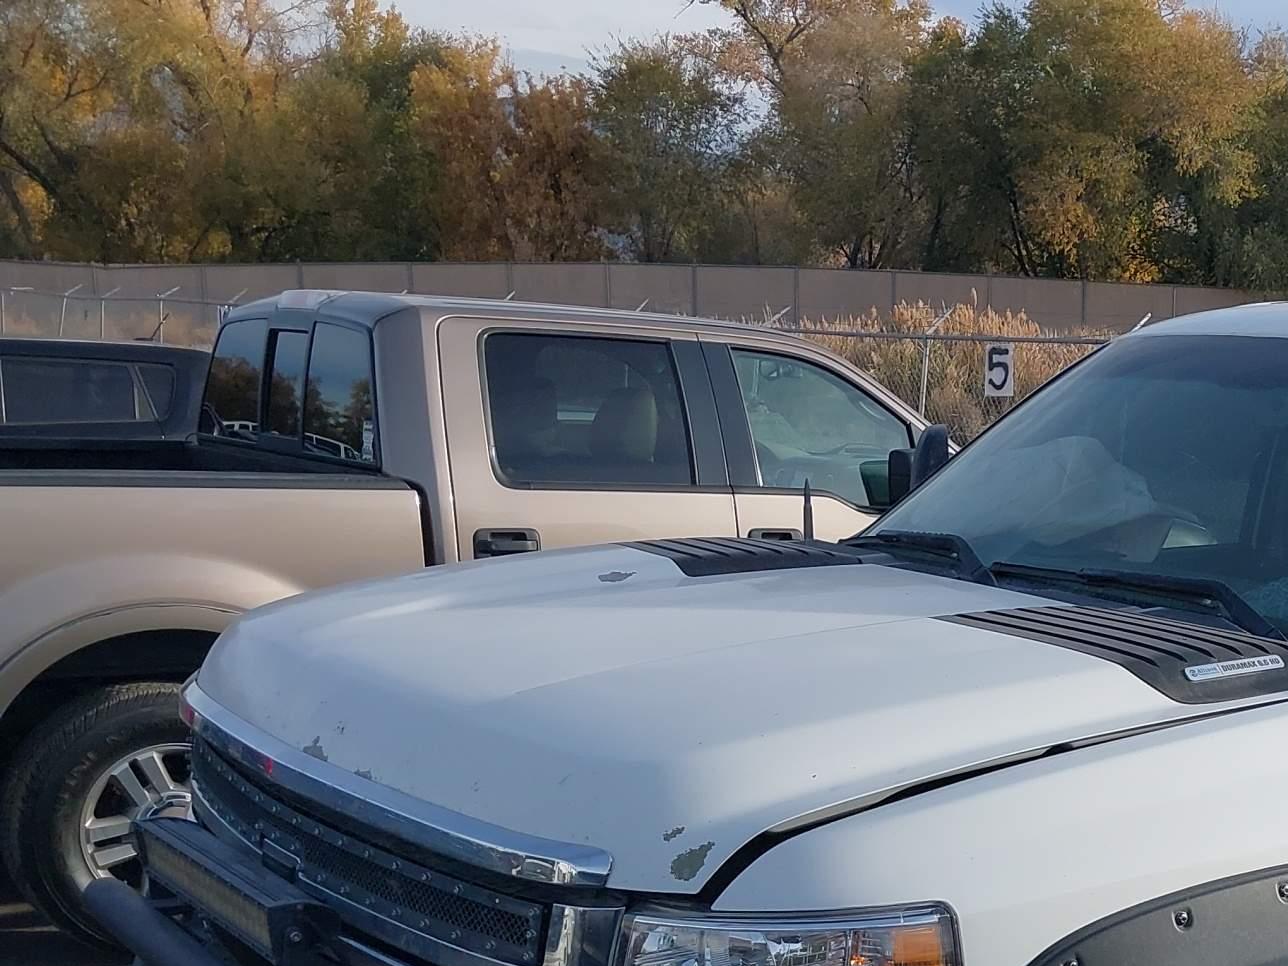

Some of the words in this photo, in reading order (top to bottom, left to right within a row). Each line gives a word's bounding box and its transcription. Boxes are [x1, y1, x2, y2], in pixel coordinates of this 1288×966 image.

[988, 346, 1009, 391] 5
[1221, 660, 1257, 673] DURAMAX
[1269, 657, 1281, 666] HD
